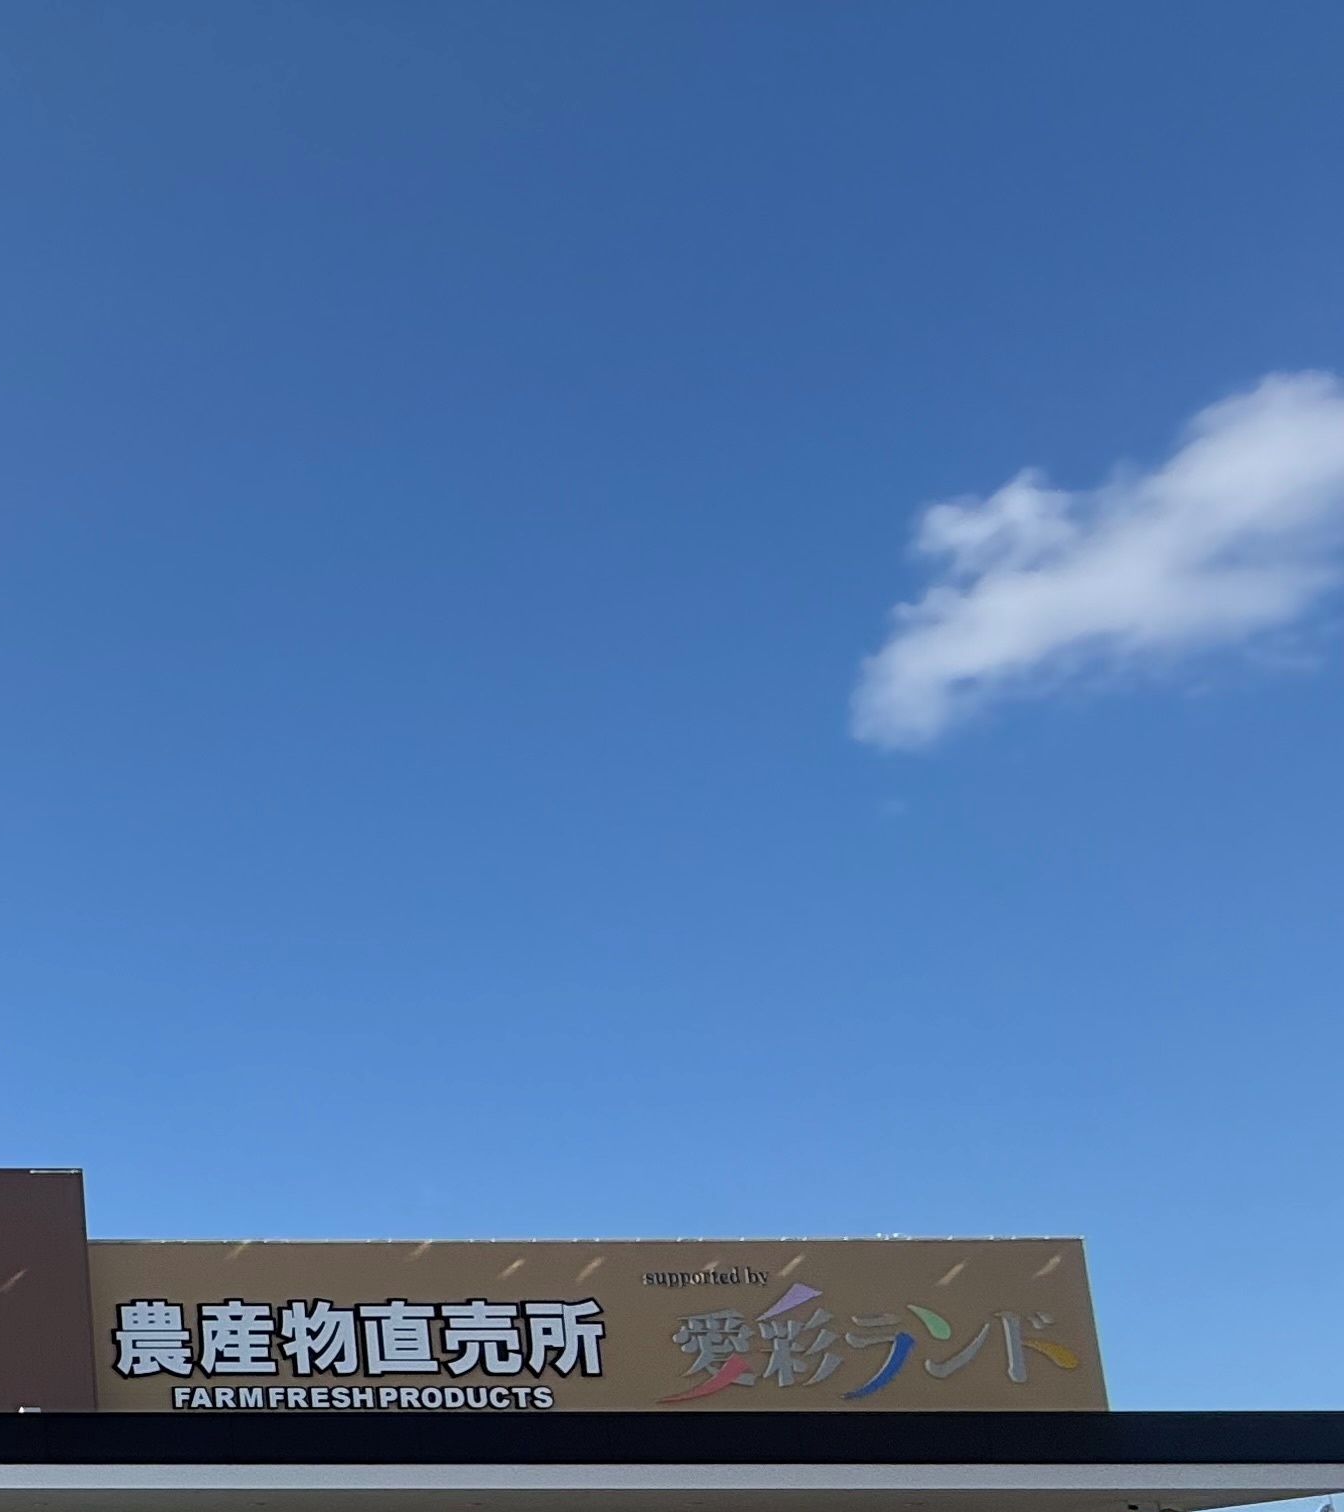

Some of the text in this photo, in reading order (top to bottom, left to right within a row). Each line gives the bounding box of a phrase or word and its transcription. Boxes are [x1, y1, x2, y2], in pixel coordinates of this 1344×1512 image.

[643, 1266, 769, 1288] supported by
[111, 1299, 605, 1377] 農産物直売所
[654, 1283, 1080, 1403] 愛彩ランド
[173, 1386, 554, 1409] FARM FRESH PRODUCTS
